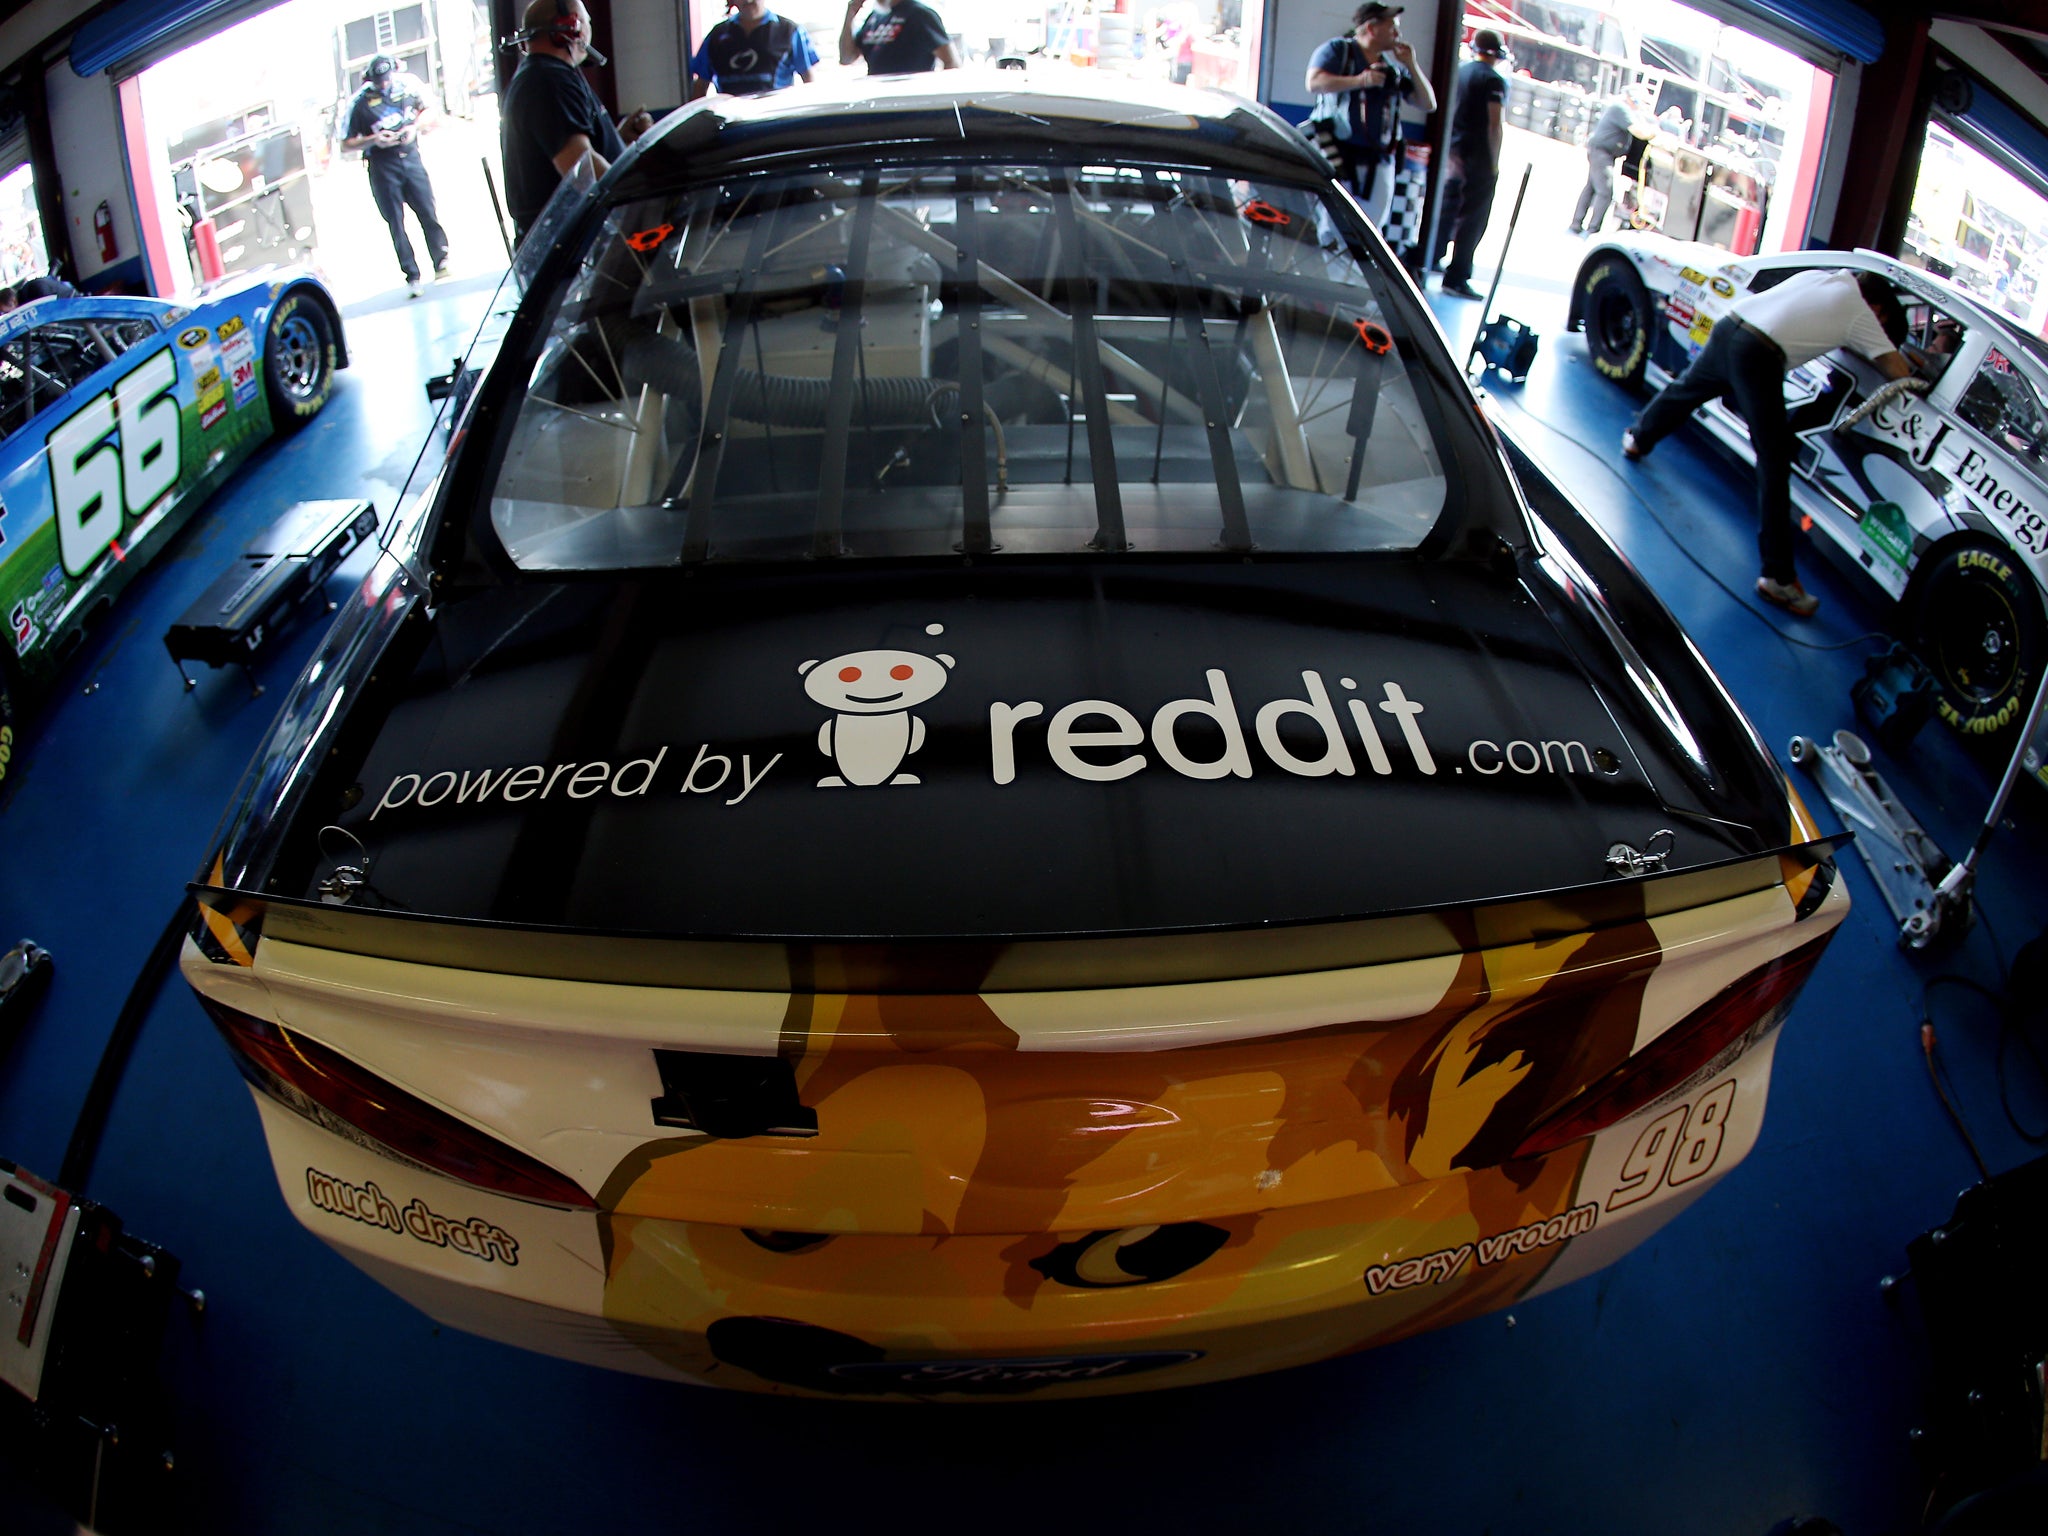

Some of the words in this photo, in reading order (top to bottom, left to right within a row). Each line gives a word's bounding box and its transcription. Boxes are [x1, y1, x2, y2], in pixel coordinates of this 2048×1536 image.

[232, 361, 254, 387] 3M
[45, 344, 183, 580] 66
[1913, 420, 1955, 466] J
[1957, 549, 2012, 583] EAGLE
[245, 624, 264, 651] LF
[368, 745, 669, 820] powered
[680, 744, 783, 806] by
[1606, 1078, 1737, 1212] 98
[307, 1167, 403, 1235] much
[403, 1198, 519, 1266] draft
[1366, 1243, 1473, 1296] very
[1478, 1201, 1599, 1270] vroom
[900, 1358, 1131, 1384] Ford
